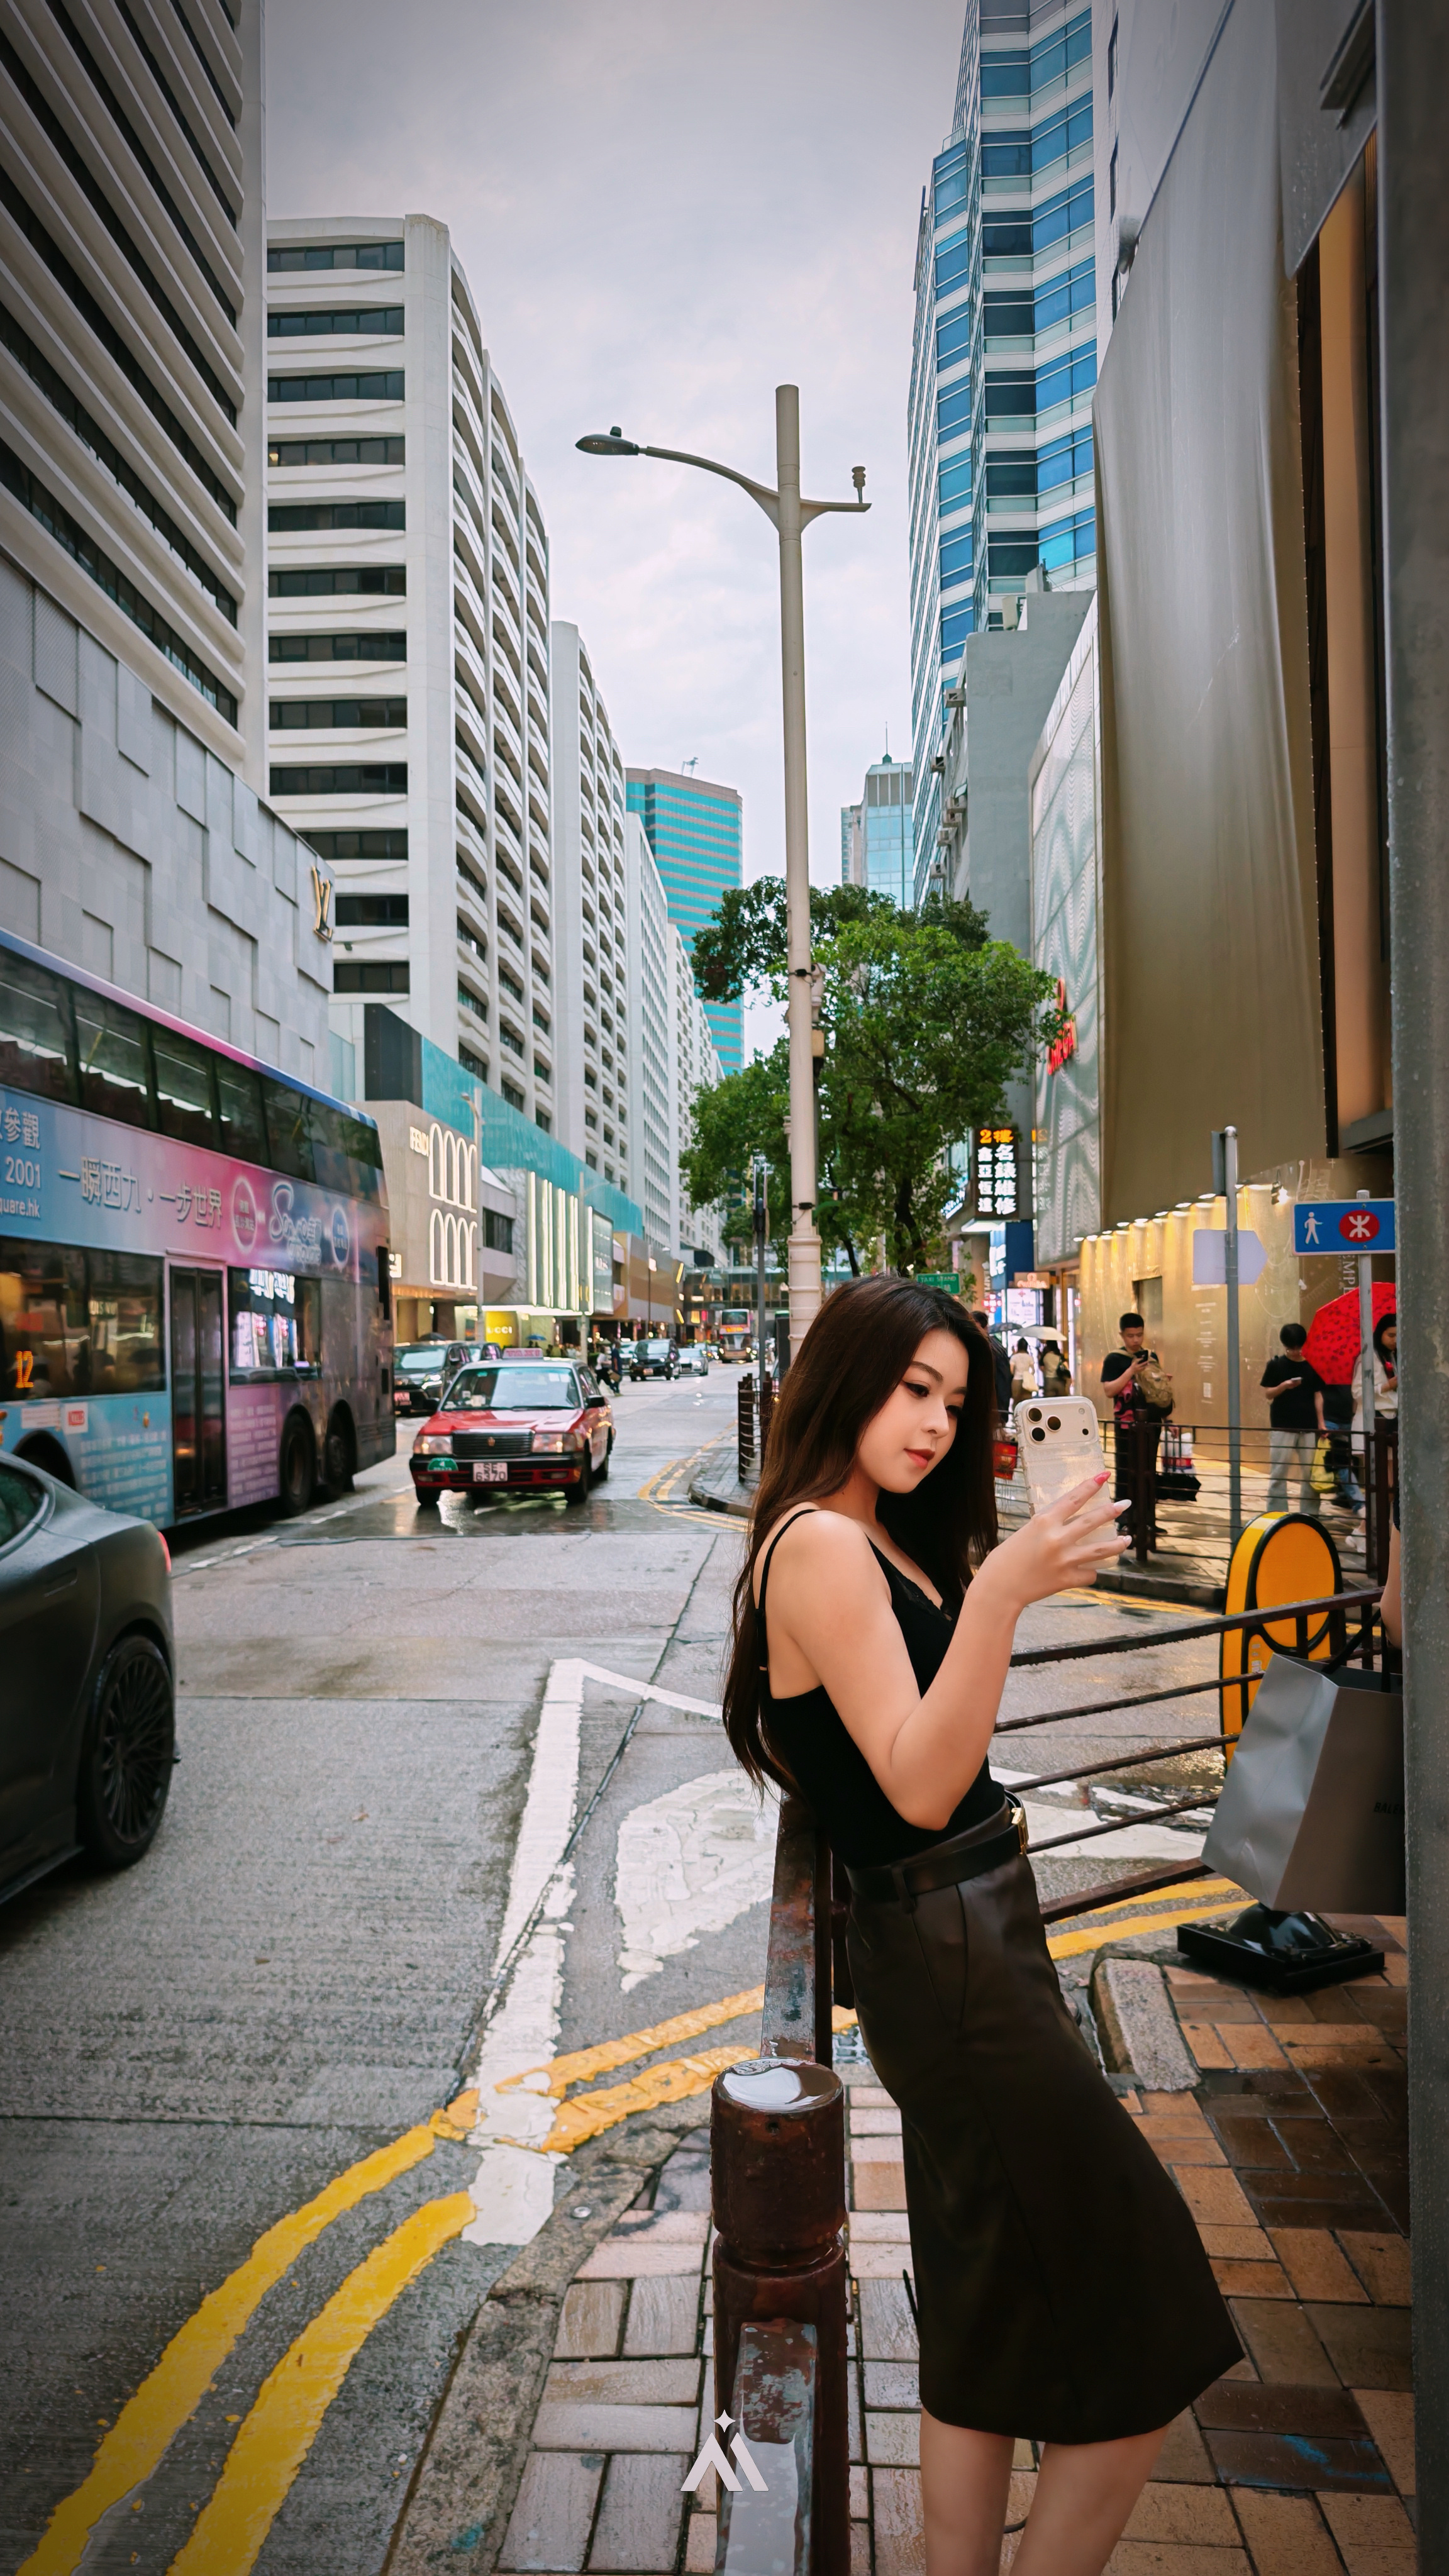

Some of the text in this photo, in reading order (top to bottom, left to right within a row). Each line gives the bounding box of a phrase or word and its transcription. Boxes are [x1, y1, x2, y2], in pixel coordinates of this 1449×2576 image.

[0, 1106, 40, 1150] 參觀
[5, 1156, 41, 1189] 2001
[486, 1326, 513, 1334] UCCI
[16, 1351, 34, 1388] 12
[475, 1471, 506, 1482] 6370
[483, 1463, 498, 1472] SE
